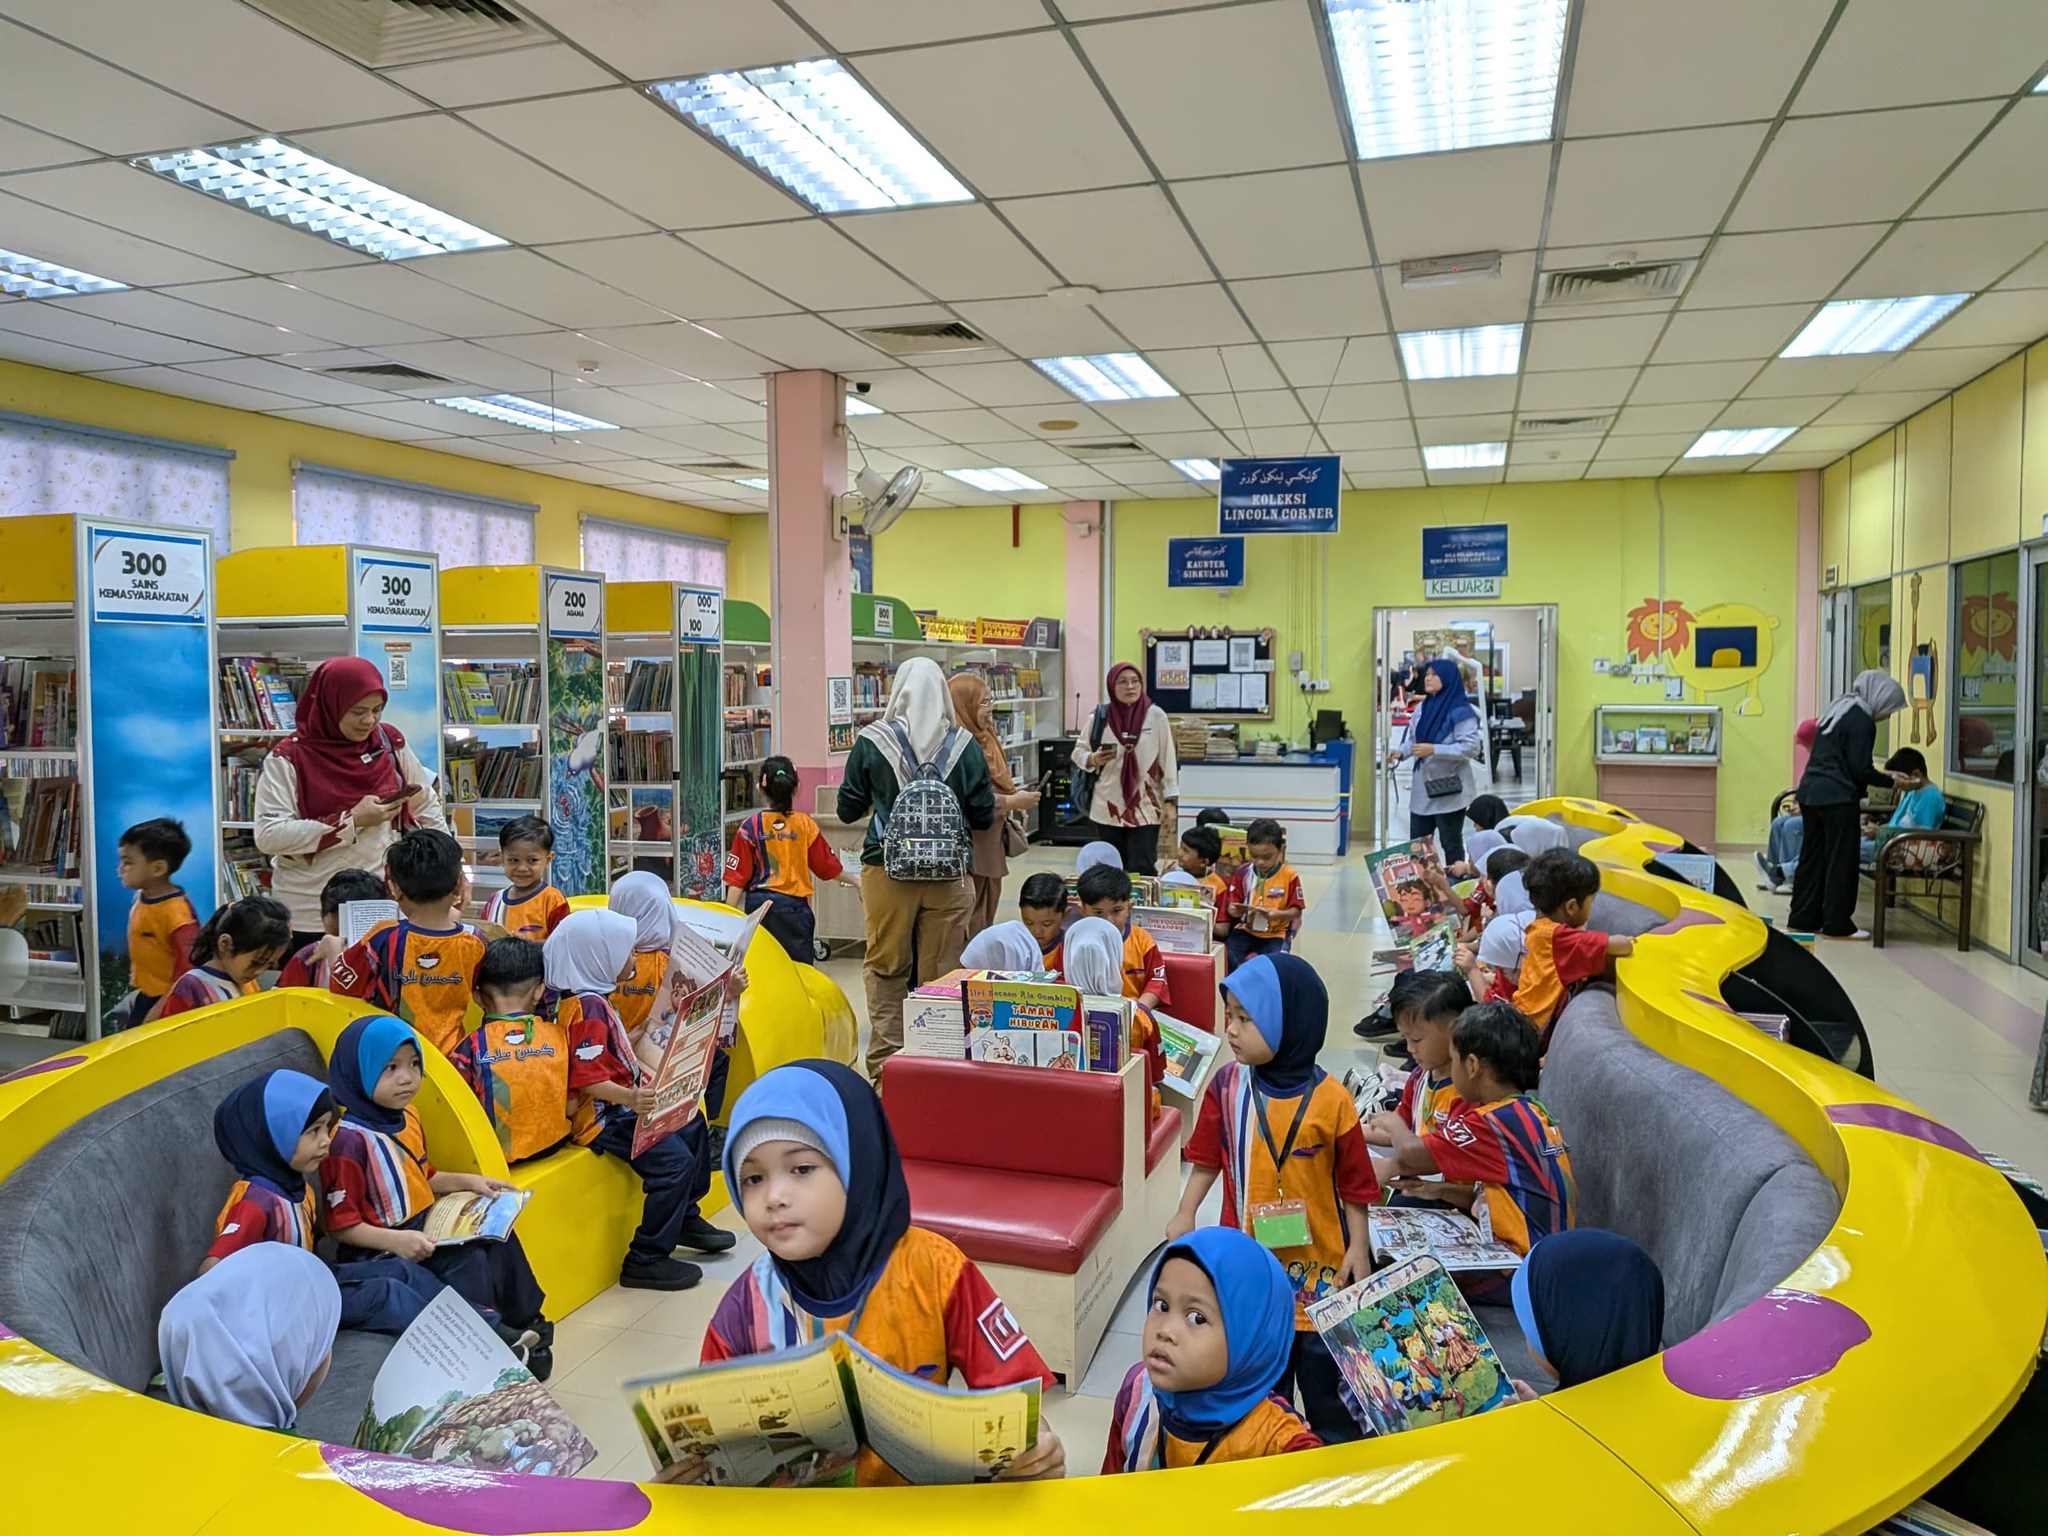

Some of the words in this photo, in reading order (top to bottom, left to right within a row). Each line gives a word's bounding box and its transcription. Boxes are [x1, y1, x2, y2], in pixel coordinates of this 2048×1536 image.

[1252, 493, 1307, 506] KOLEKSI
[1224, 508, 1278, 521] LINCOLN
[1281, 507, 1334, 520] CORNER
[121, 550, 167, 577] 300
[1186, 560, 1226, 569] KAUNTER
[1183, 570, 1229, 578] SIRKULASI
[131, 579, 159, 590] SAINS
[381, 575, 411, 596] 300
[1431, 580, 1482, 594] KELUAR
[99, 588, 189, 603] KEMASYARAKATAN
[564, 591, 586, 608] 200
[697, 595, 712, 608] 000
[388, 598, 406, 607] SAINS
[367, 605, 426, 617] KEMASYARAKATAN
[566, 609, 585, 618] AGAMA
[689, 618, 702, 632] 100
[988, 989, 1018, 998] Bacaan
[1012, 1004, 1055, 1018] TAMAN
[1009, 1018, 1060, 1030] HIBURAN
